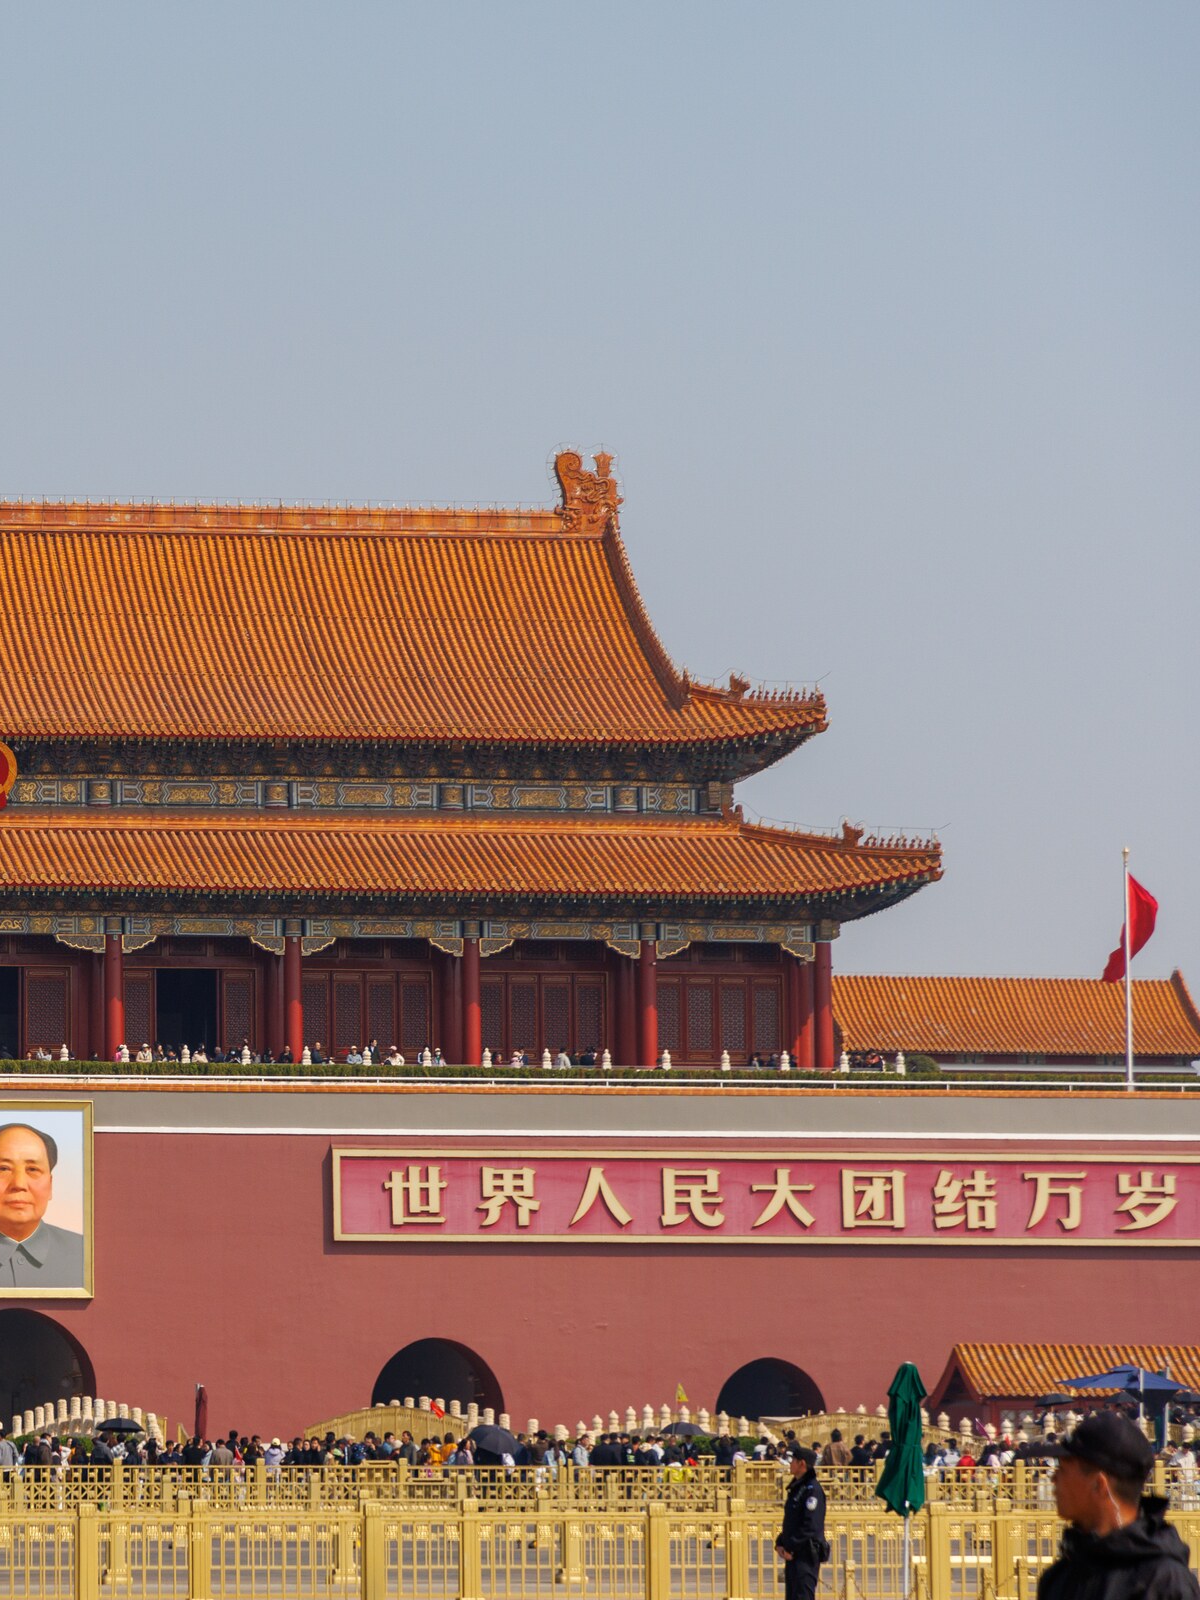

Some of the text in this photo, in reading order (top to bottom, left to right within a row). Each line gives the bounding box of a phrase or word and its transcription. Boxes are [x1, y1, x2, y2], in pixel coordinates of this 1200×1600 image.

[384, 1165, 1179, 1231] 世界人民大团结万岁
